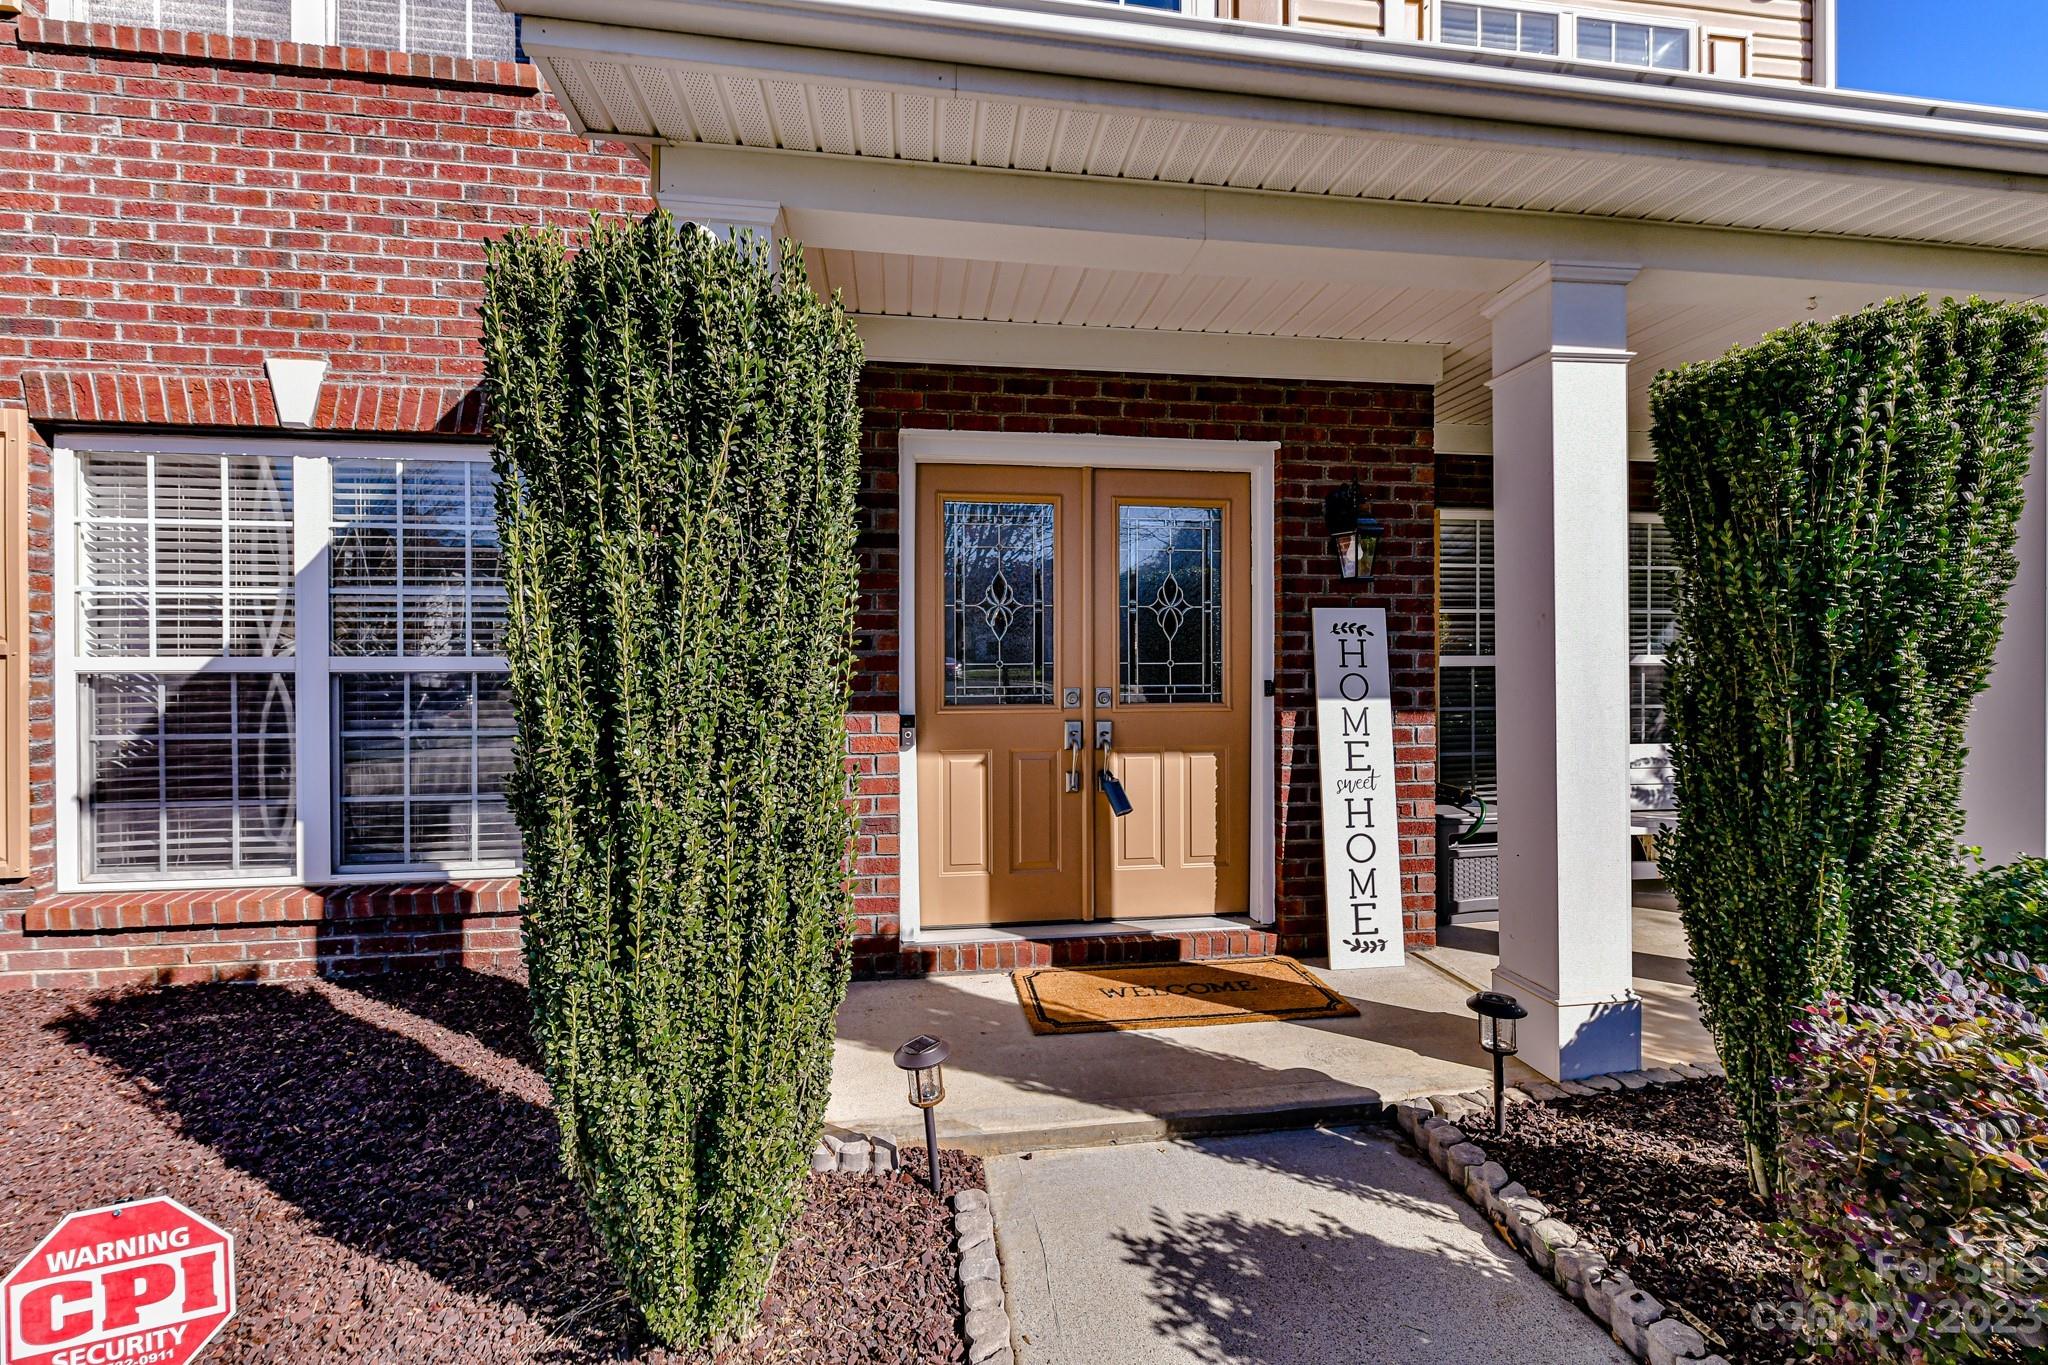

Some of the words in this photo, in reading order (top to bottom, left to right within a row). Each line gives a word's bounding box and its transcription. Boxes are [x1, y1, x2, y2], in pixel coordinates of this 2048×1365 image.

[1338, 638, 1372, 772] HOME
[1336, 768, 1381, 795] sweet
[1344, 797, 1379, 936] HOME
[1098, 978, 1258, 999] WELCOME
[46, 1226, 190, 1274] WARNING
[19, 1250, 218, 1346] CPI
[51, 1324, 189, 1365] SECURITY
